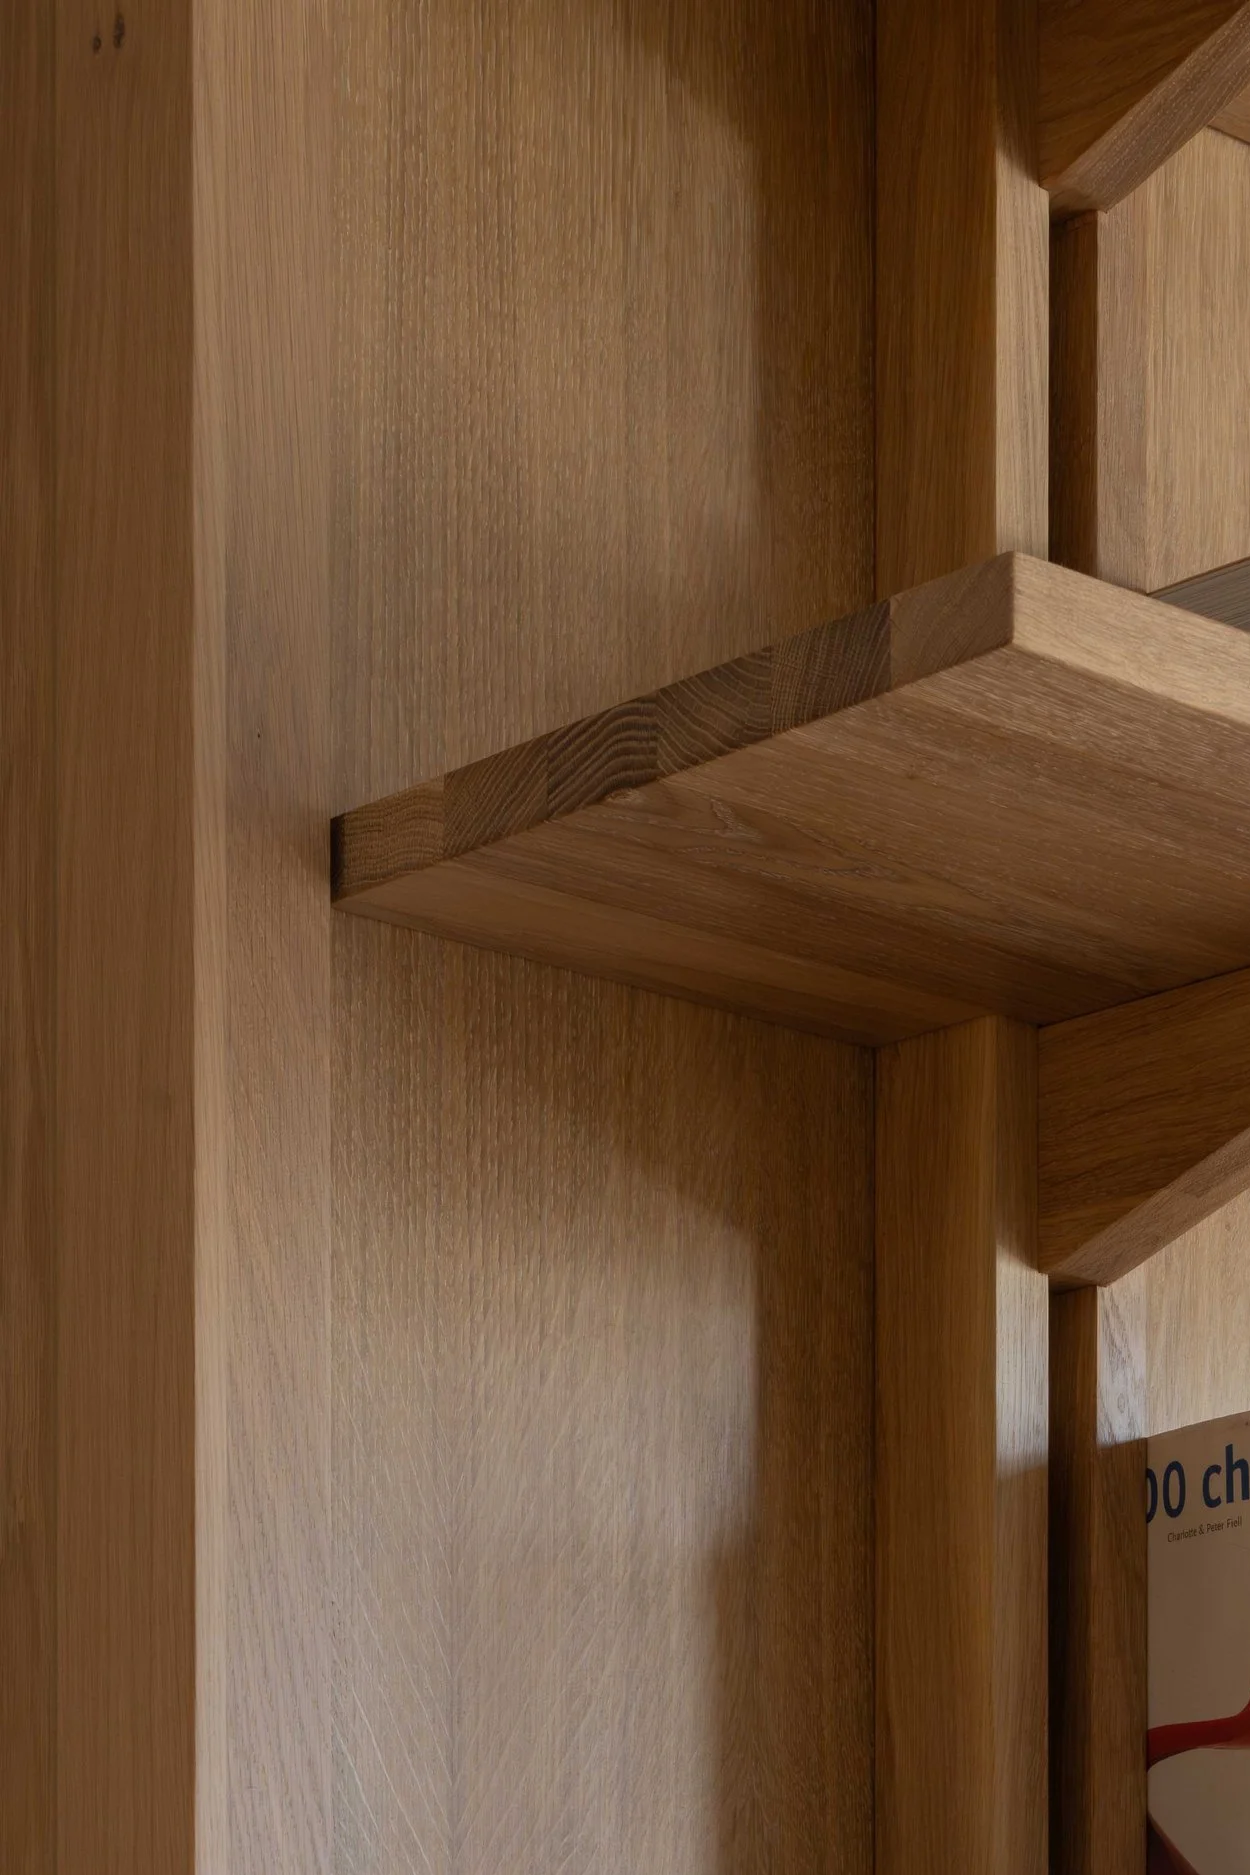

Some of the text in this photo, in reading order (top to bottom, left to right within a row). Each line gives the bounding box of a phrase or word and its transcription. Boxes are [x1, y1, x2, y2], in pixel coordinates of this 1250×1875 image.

[1167, 1527, 1197, 1542] Charlotte
[1198, 1524, 1205, 1536] &
[1206, 1522, 1224, 1533] Peter
